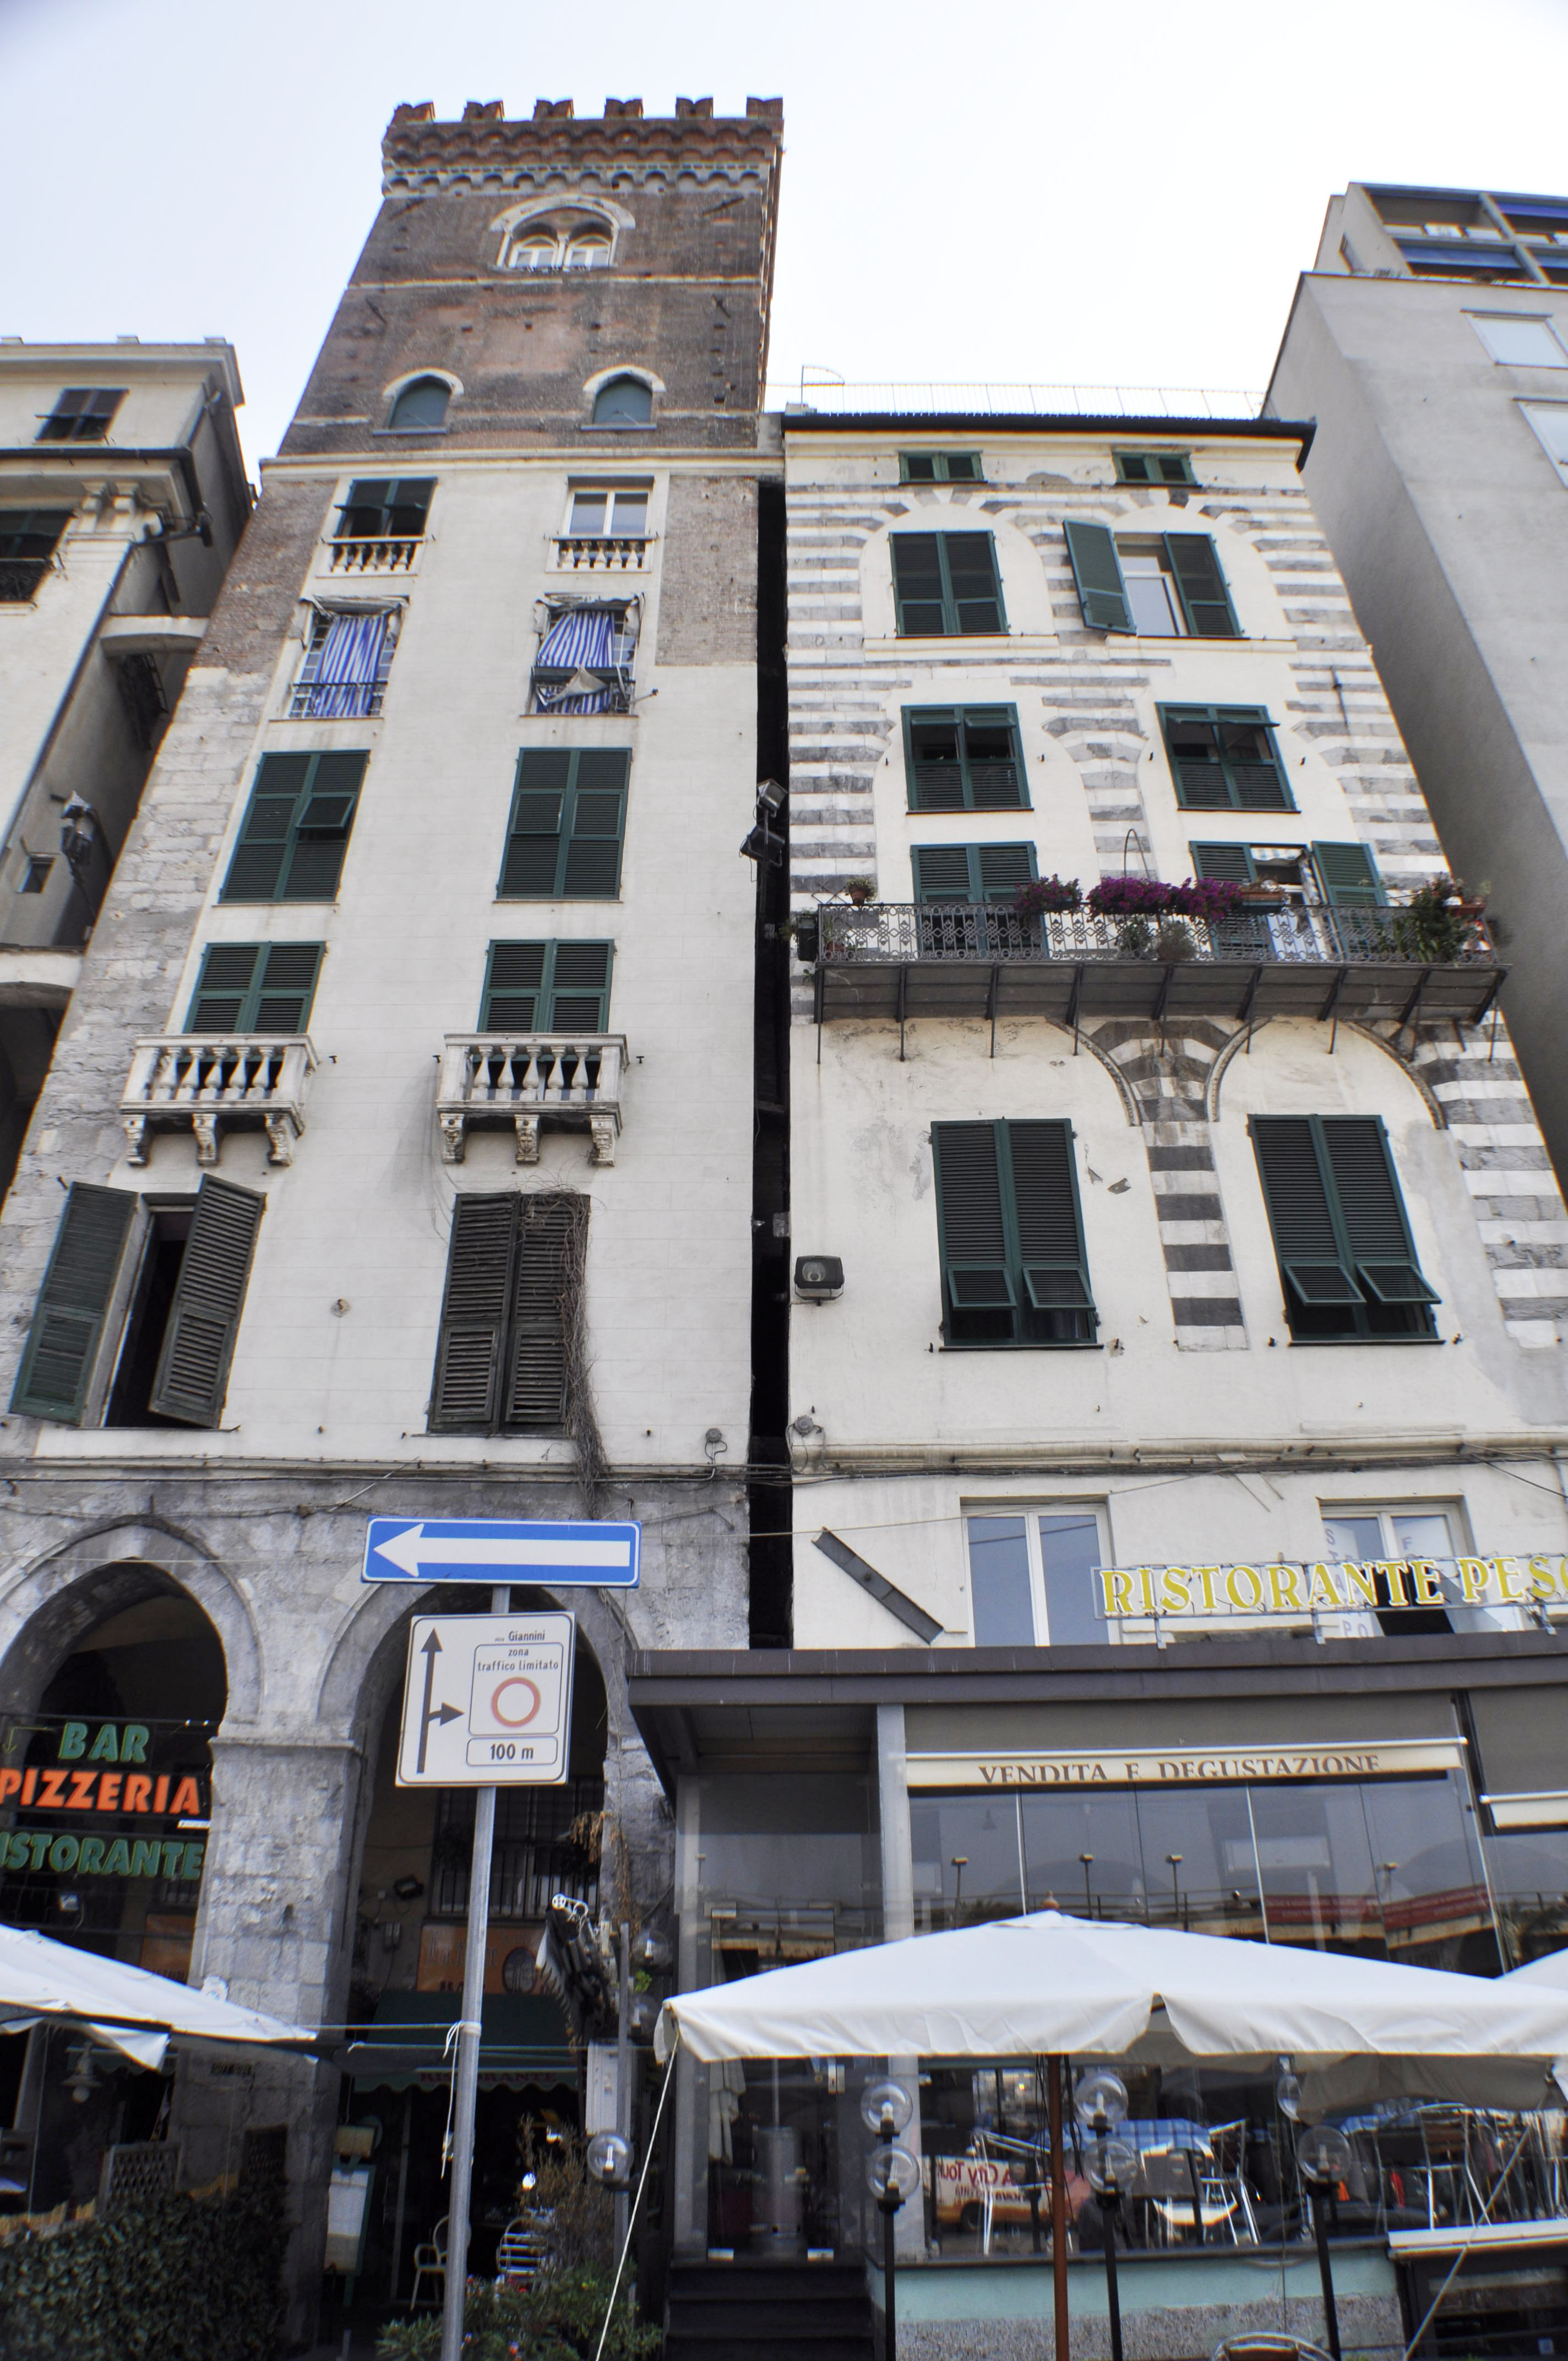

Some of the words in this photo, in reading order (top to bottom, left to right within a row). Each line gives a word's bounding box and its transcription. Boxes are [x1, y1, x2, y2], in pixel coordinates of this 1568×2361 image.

[1099, 1558, 1445, 1614] RISTORANTE
[1455, 1553, 1568, 1603] PES
[508, 1629, 545, 1641] Giannini
[508, 1648, 529, 1657] zona
[477, 1660, 515, 1672] traffico
[519, 1659, 559, 1671] limitato
[58, 1722, 149, 1763] BAR
[491, 1743, 515, 1760] 100
[521, 1747, 534, 1760] m
[978, 1762, 1108, 1784] VENDITA
[1125, 1762, 1142, 1780] E
[1157, 1755, 1380, 1779] DEGUSTAZIONE
[0, 1767, 200, 1815] PIZZERIA
